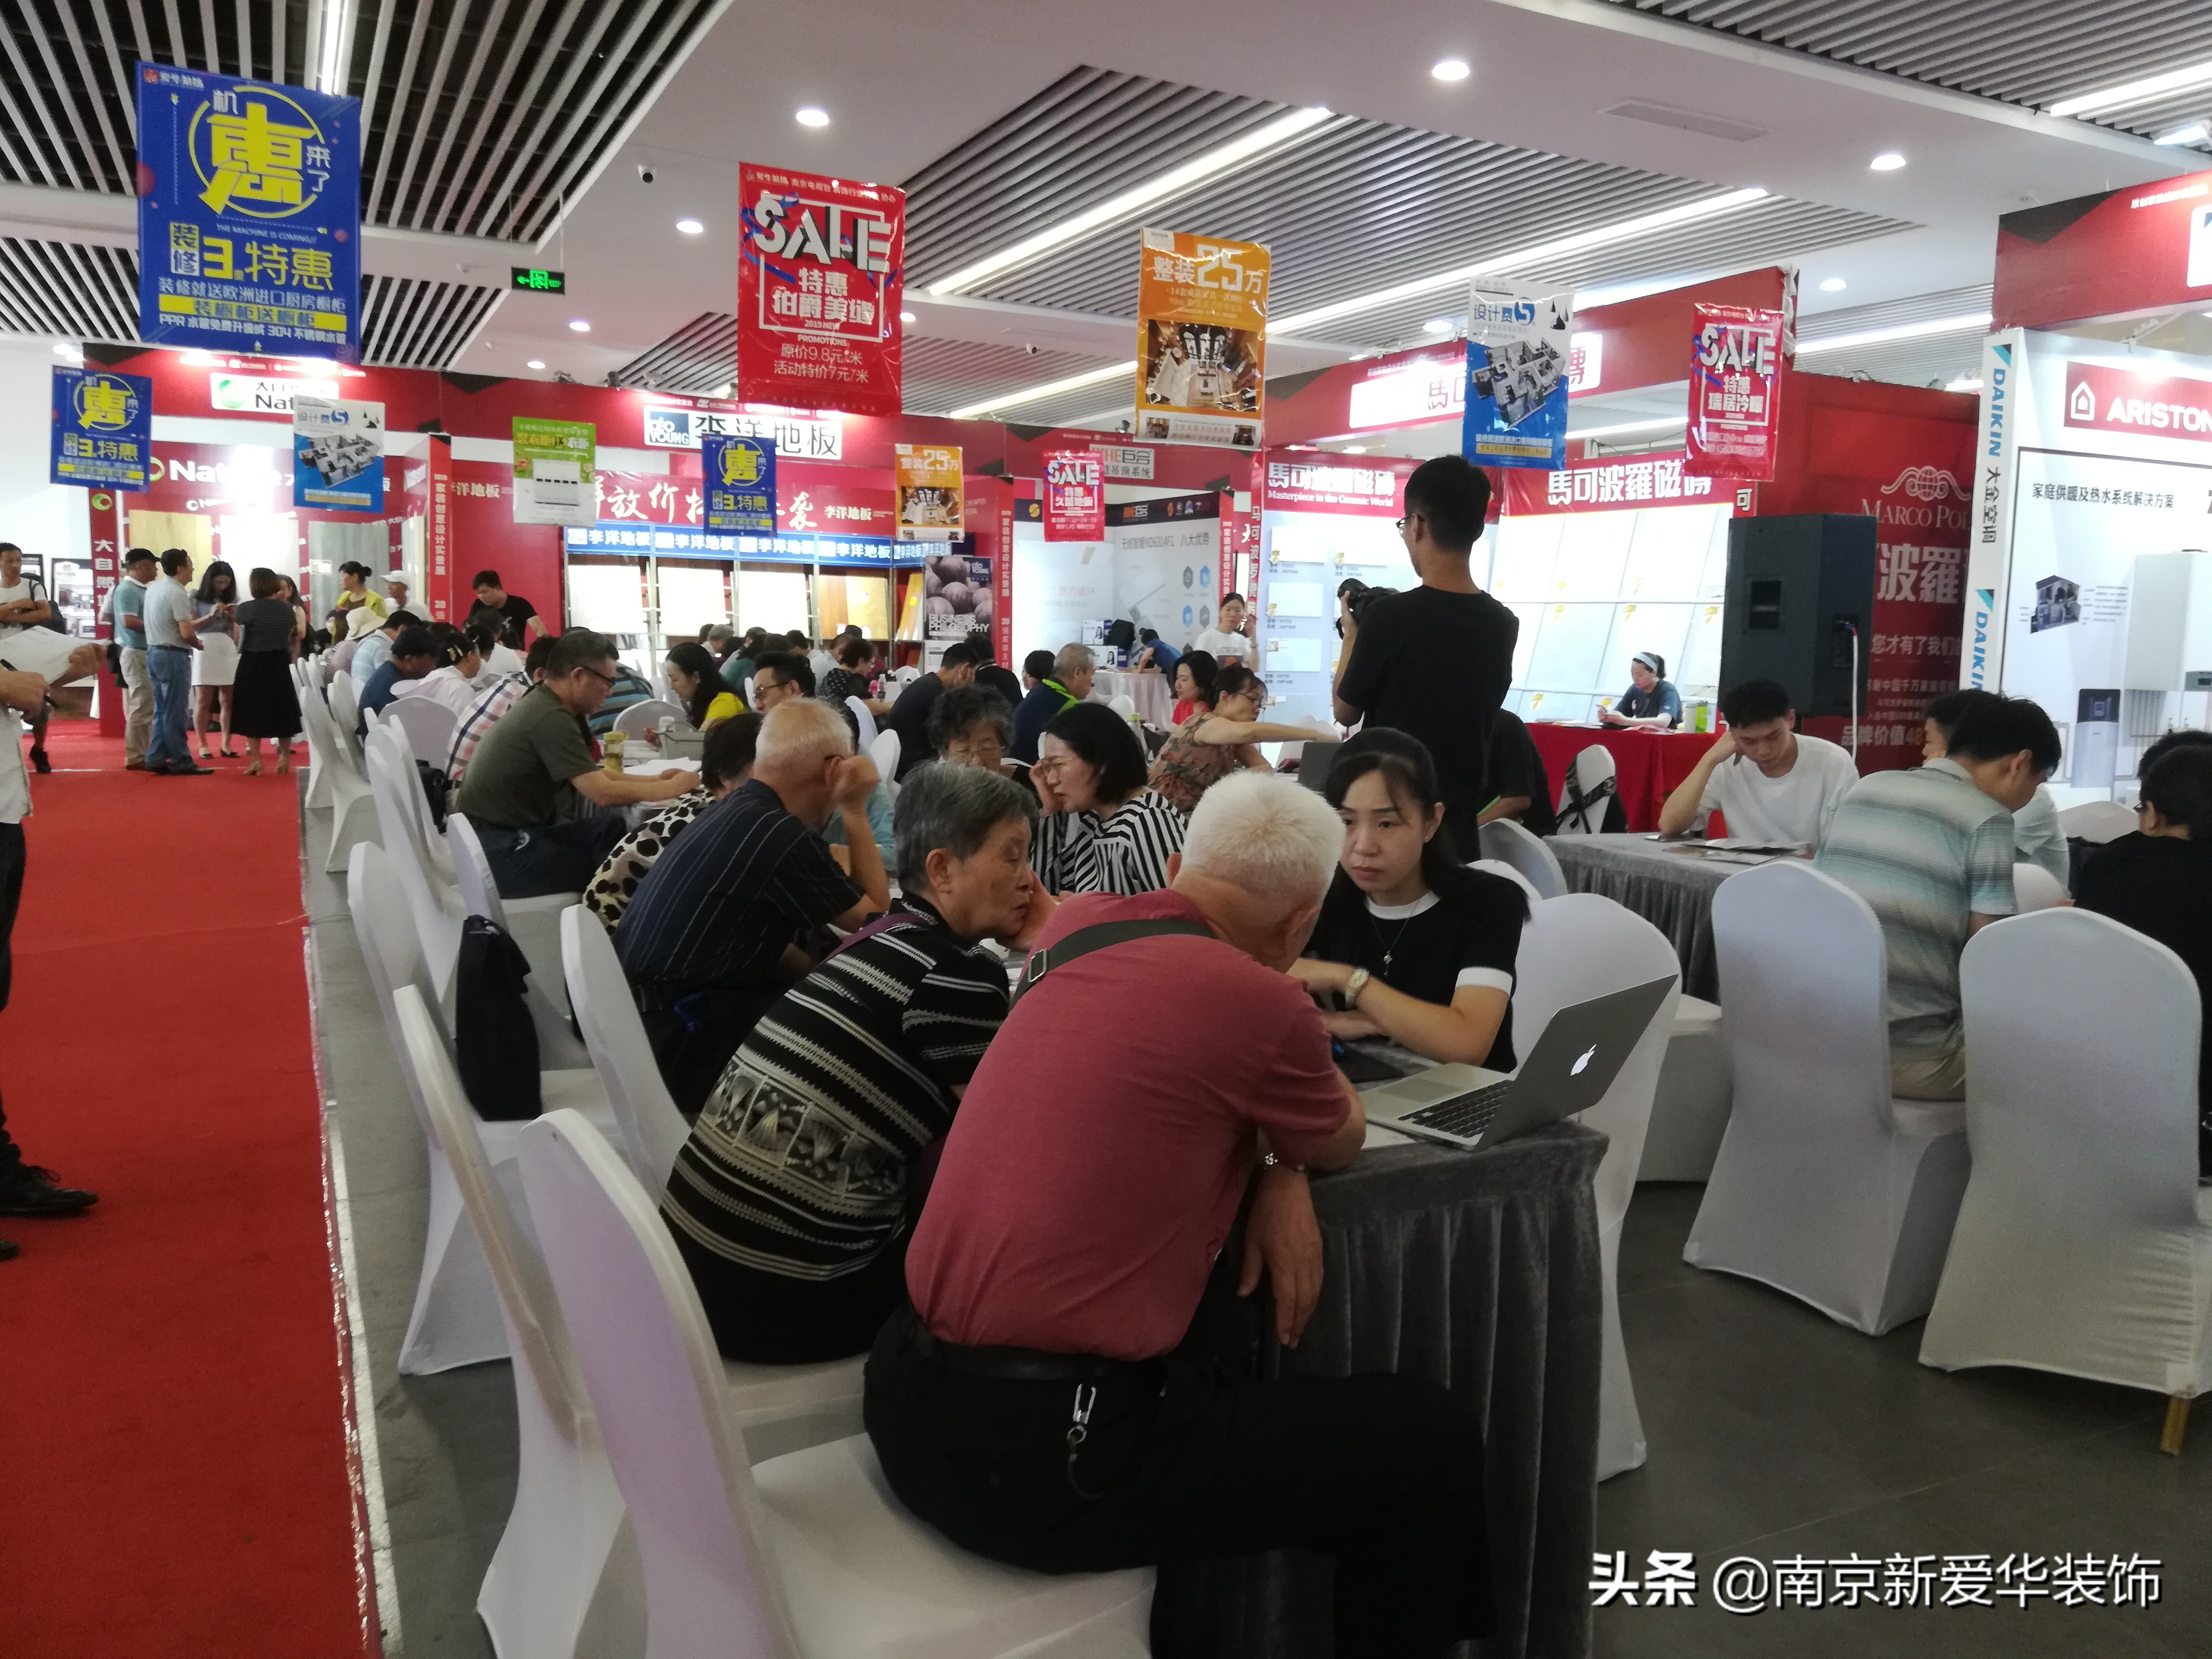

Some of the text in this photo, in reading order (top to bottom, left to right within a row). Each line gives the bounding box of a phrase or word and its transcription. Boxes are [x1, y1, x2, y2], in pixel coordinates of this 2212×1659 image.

[753, 197, 892, 273] SALE
[798, 267, 848, 296] 特惠
[797, 334, 848, 347] PROMOTIONS
[1700, 327, 1776, 375] SALE
[1723, 375, 1751, 394] 特惠
[255, 394, 294, 410] Nat
[1988, 368, 2006, 457] DAIKIN
[2106, 397, 2212, 433] ARISTON
[650, 431, 690, 445] YOUNG
[1047, 461, 1099, 485] SALE
[1268, 490, 1315, 503] Masterpiece
[1370, 497, 1394, 507] World
[2032, 483, 2175, 508] 家庭供暖及热水系统解决方案
[824, 505, 872, 521] 李洋地板
[836, 542, 891, 559] 李洋地板
[1876, 543, 1969, 604] 波羅
[929, 613, 976, 624] BUSINESS
[929, 623, 990, 633] PHILOSOPHY
